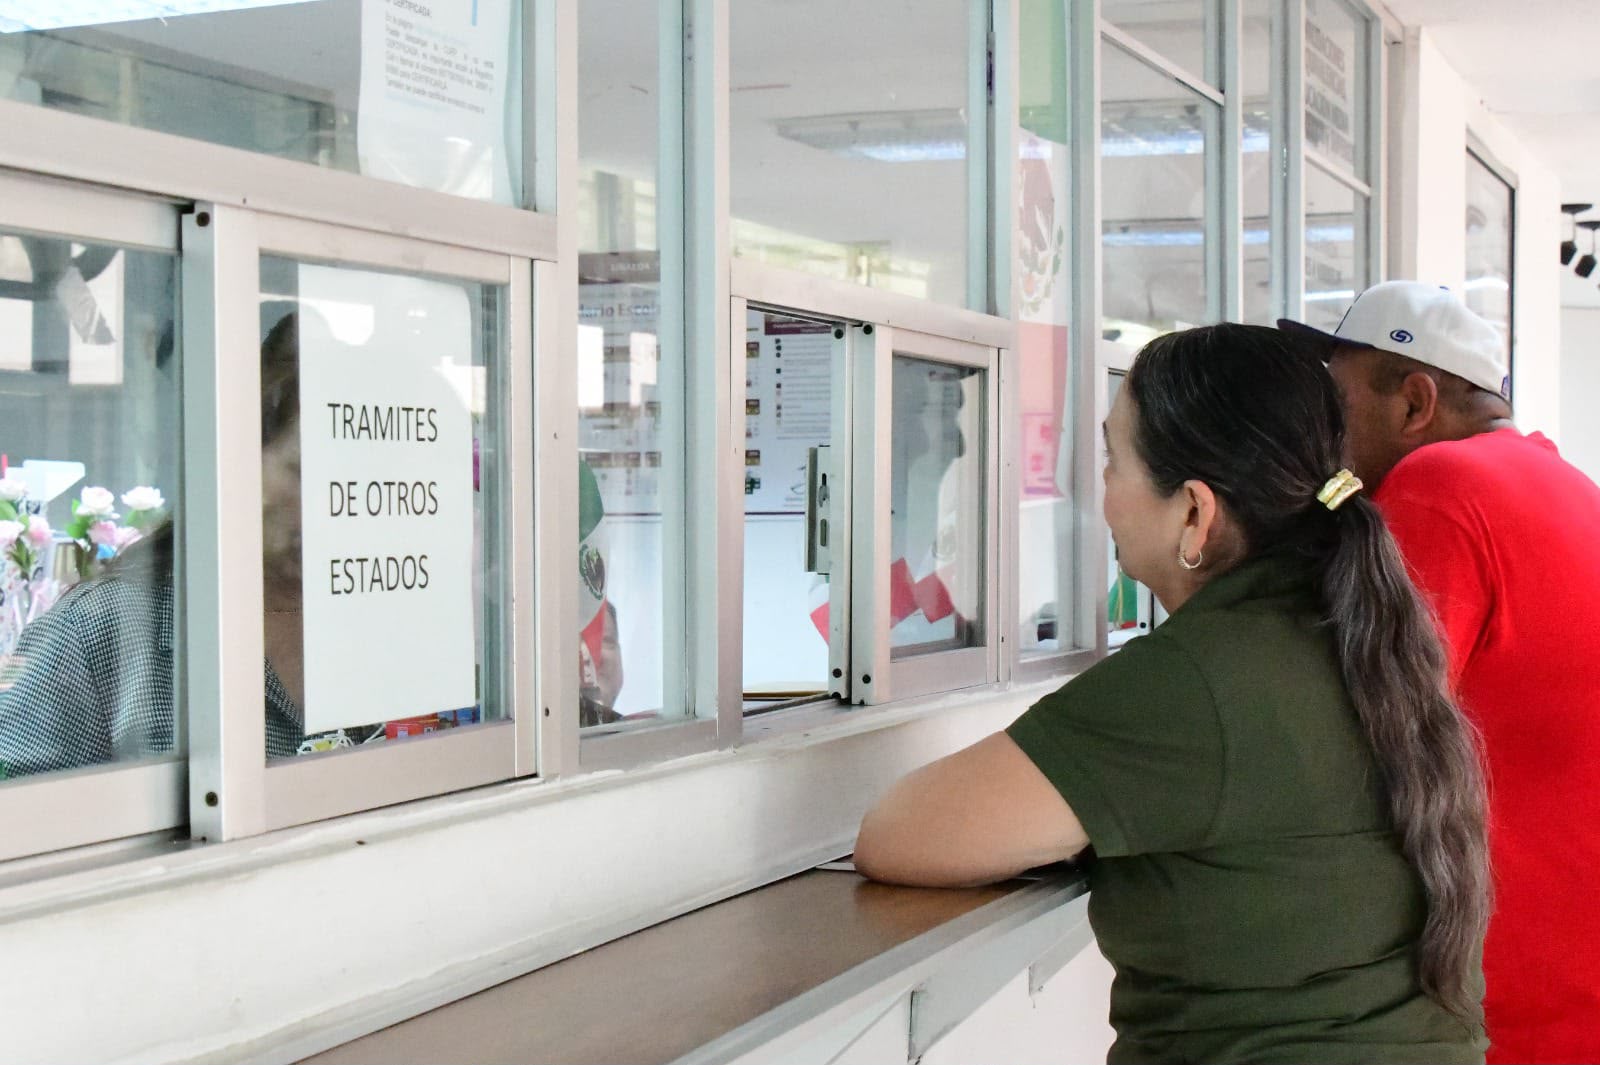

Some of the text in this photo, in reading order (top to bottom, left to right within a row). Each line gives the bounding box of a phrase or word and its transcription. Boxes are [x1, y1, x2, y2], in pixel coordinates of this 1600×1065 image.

[327, 403, 438, 442] TRAMITES
[330, 481, 438, 517] DE OTROS
[331, 554, 429, 595] ESTADOS
